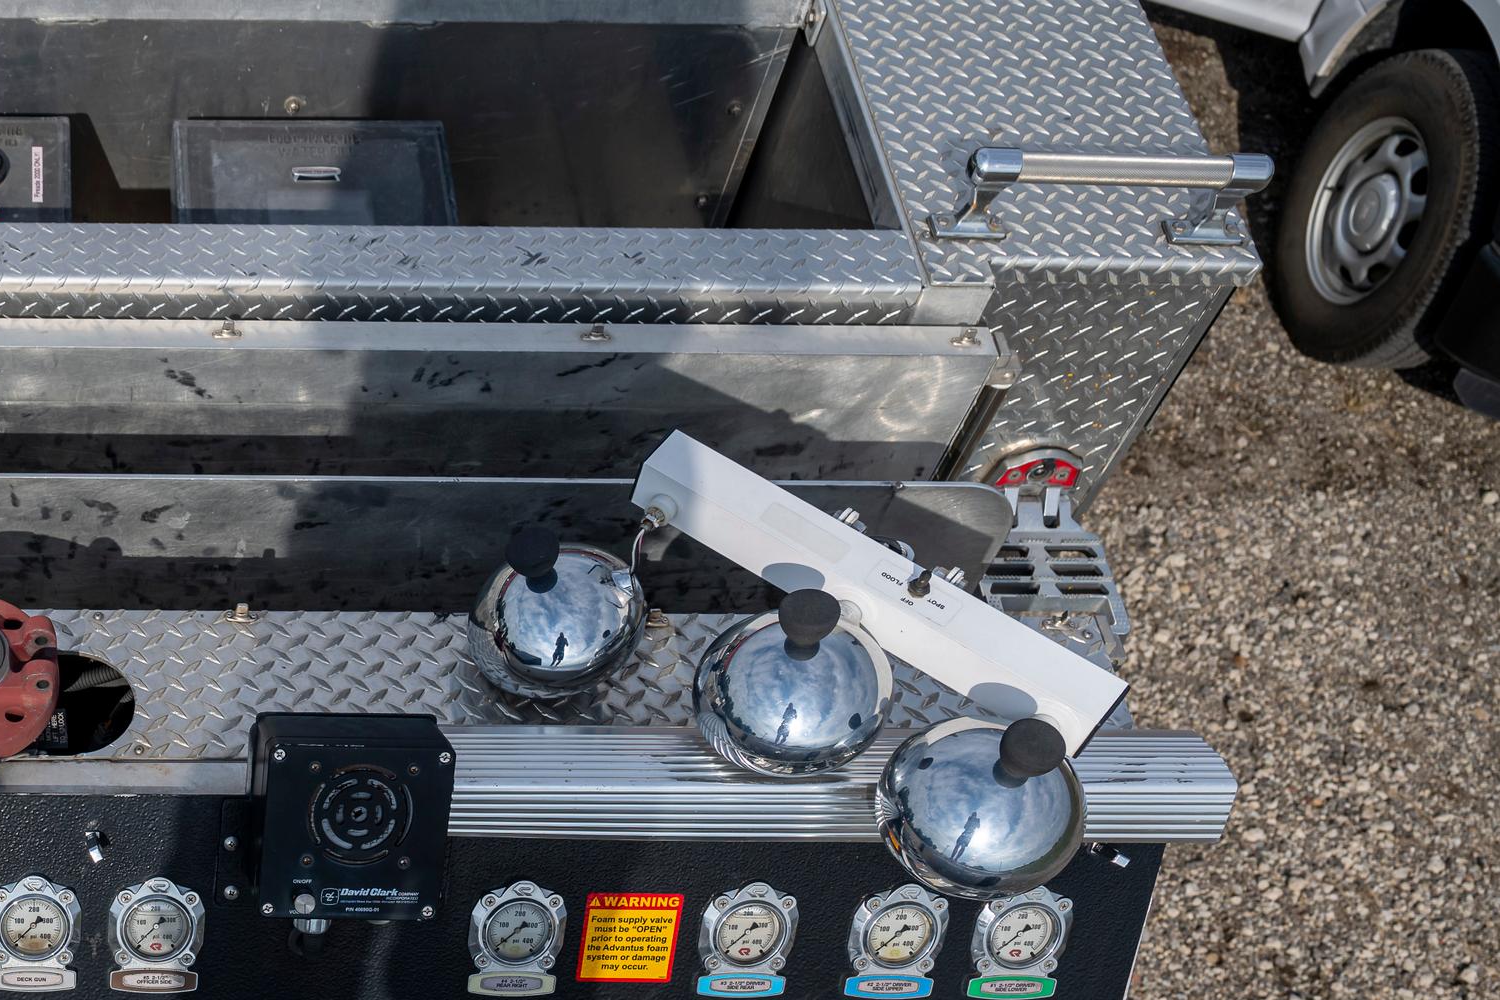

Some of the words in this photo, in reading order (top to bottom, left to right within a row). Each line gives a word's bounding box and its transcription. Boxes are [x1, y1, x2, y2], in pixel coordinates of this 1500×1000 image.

[881, 571, 903, 586] FLOOD
[927, 598, 945, 610] SPOT
[340, 888, 368, 896] David
[369, 888, 398, 896] Clark
[604, 896, 680, 908] WARNING
[618, 916, 648, 925] supply
[626, 935, 667, 944] operating
[632, 954, 666, 963] damage
